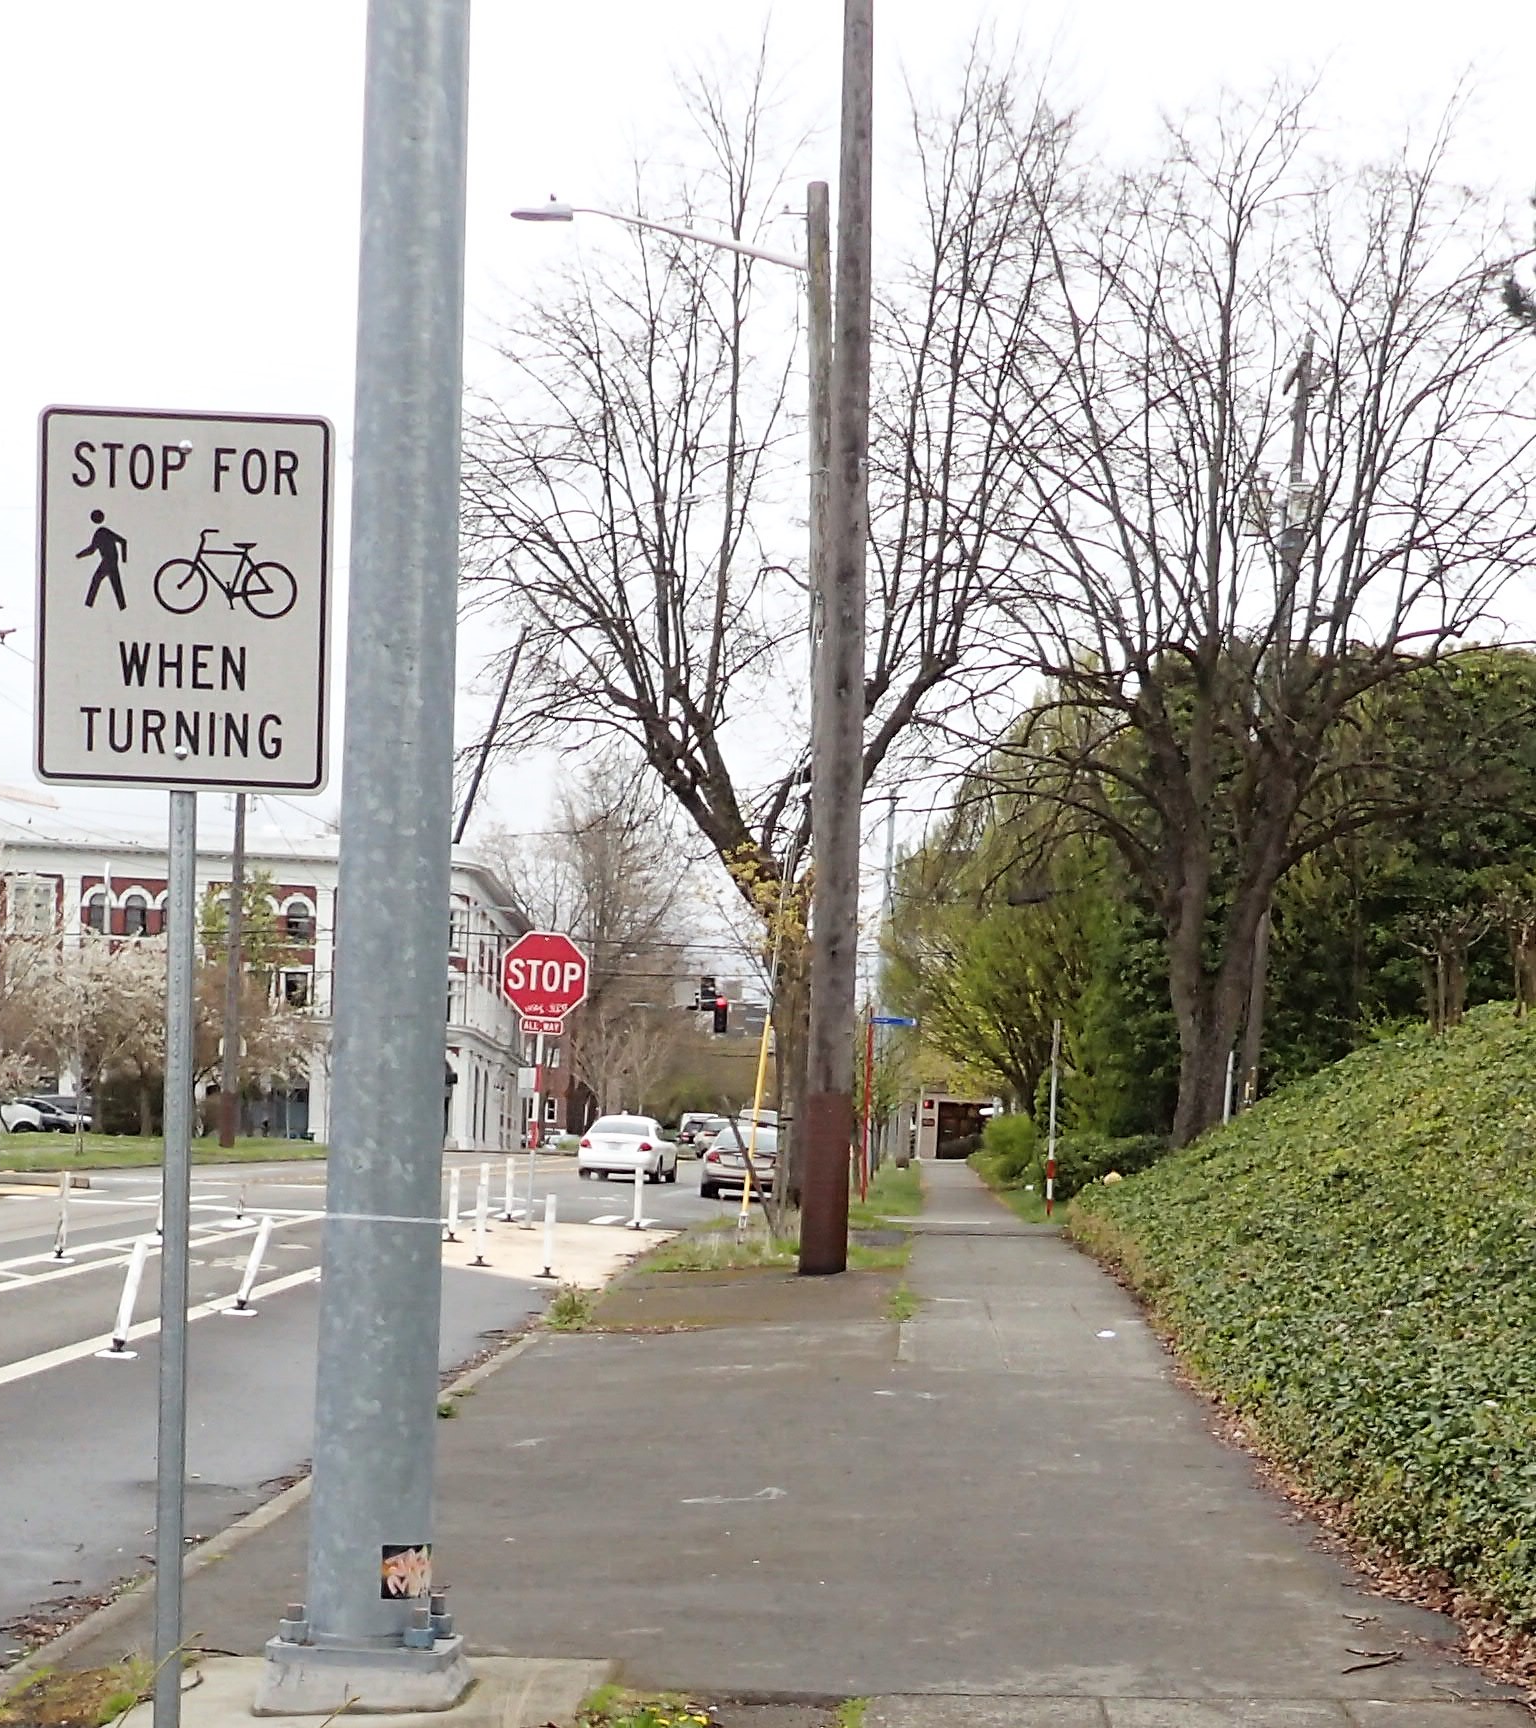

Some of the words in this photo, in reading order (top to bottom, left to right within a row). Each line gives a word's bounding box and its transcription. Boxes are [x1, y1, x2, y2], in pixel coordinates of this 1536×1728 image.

[72, 441, 187, 491] STOP
[214, 448, 299, 496] FOR
[119, 641, 246, 691] WHEN
[80, 706, 282, 760] TURNING
[507, 958, 582, 993] STOP
[524, 1020, 539, 1031] ALL
[543, 1022, 559, 1032] WAY
